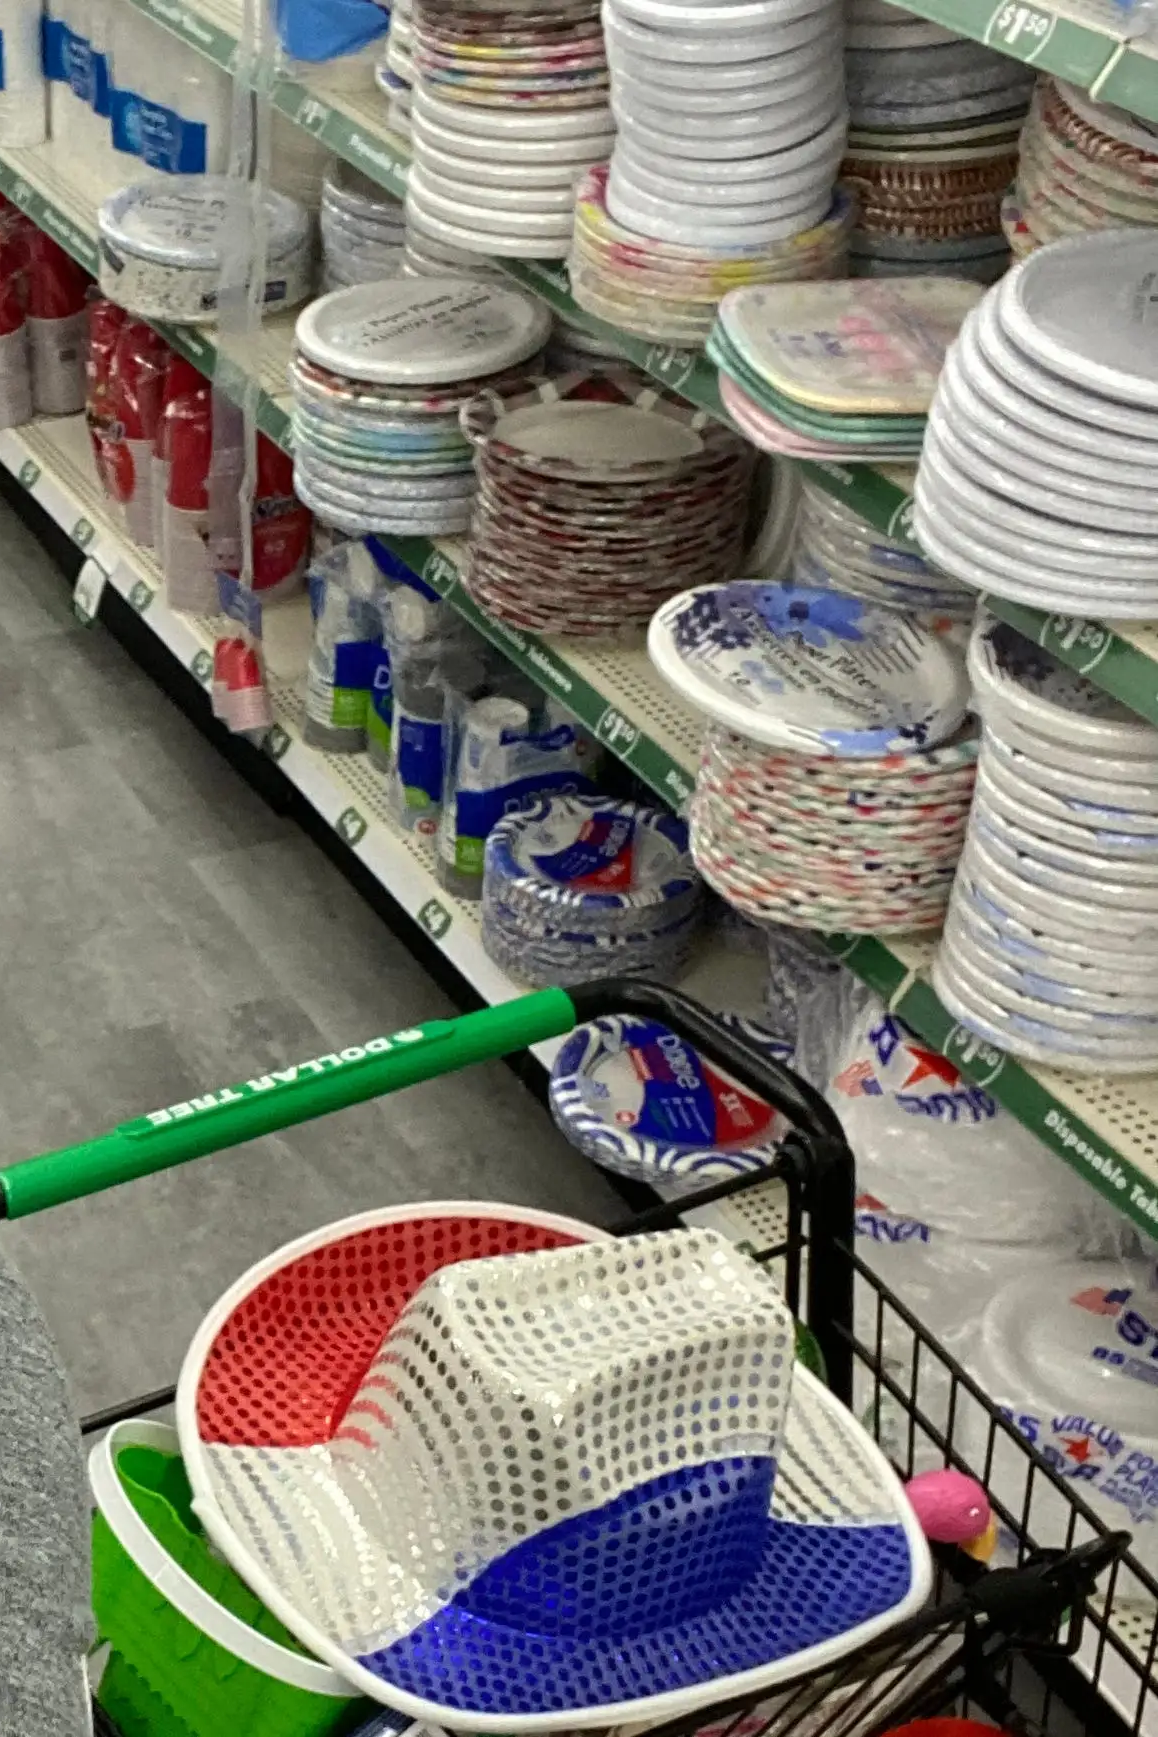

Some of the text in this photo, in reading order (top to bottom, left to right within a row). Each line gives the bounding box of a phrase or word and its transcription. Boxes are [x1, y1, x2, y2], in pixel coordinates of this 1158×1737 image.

[145, 1036, 394, 1127] DOLLAR TREE
[1043, 1109, 1127, 1191] Disposable
